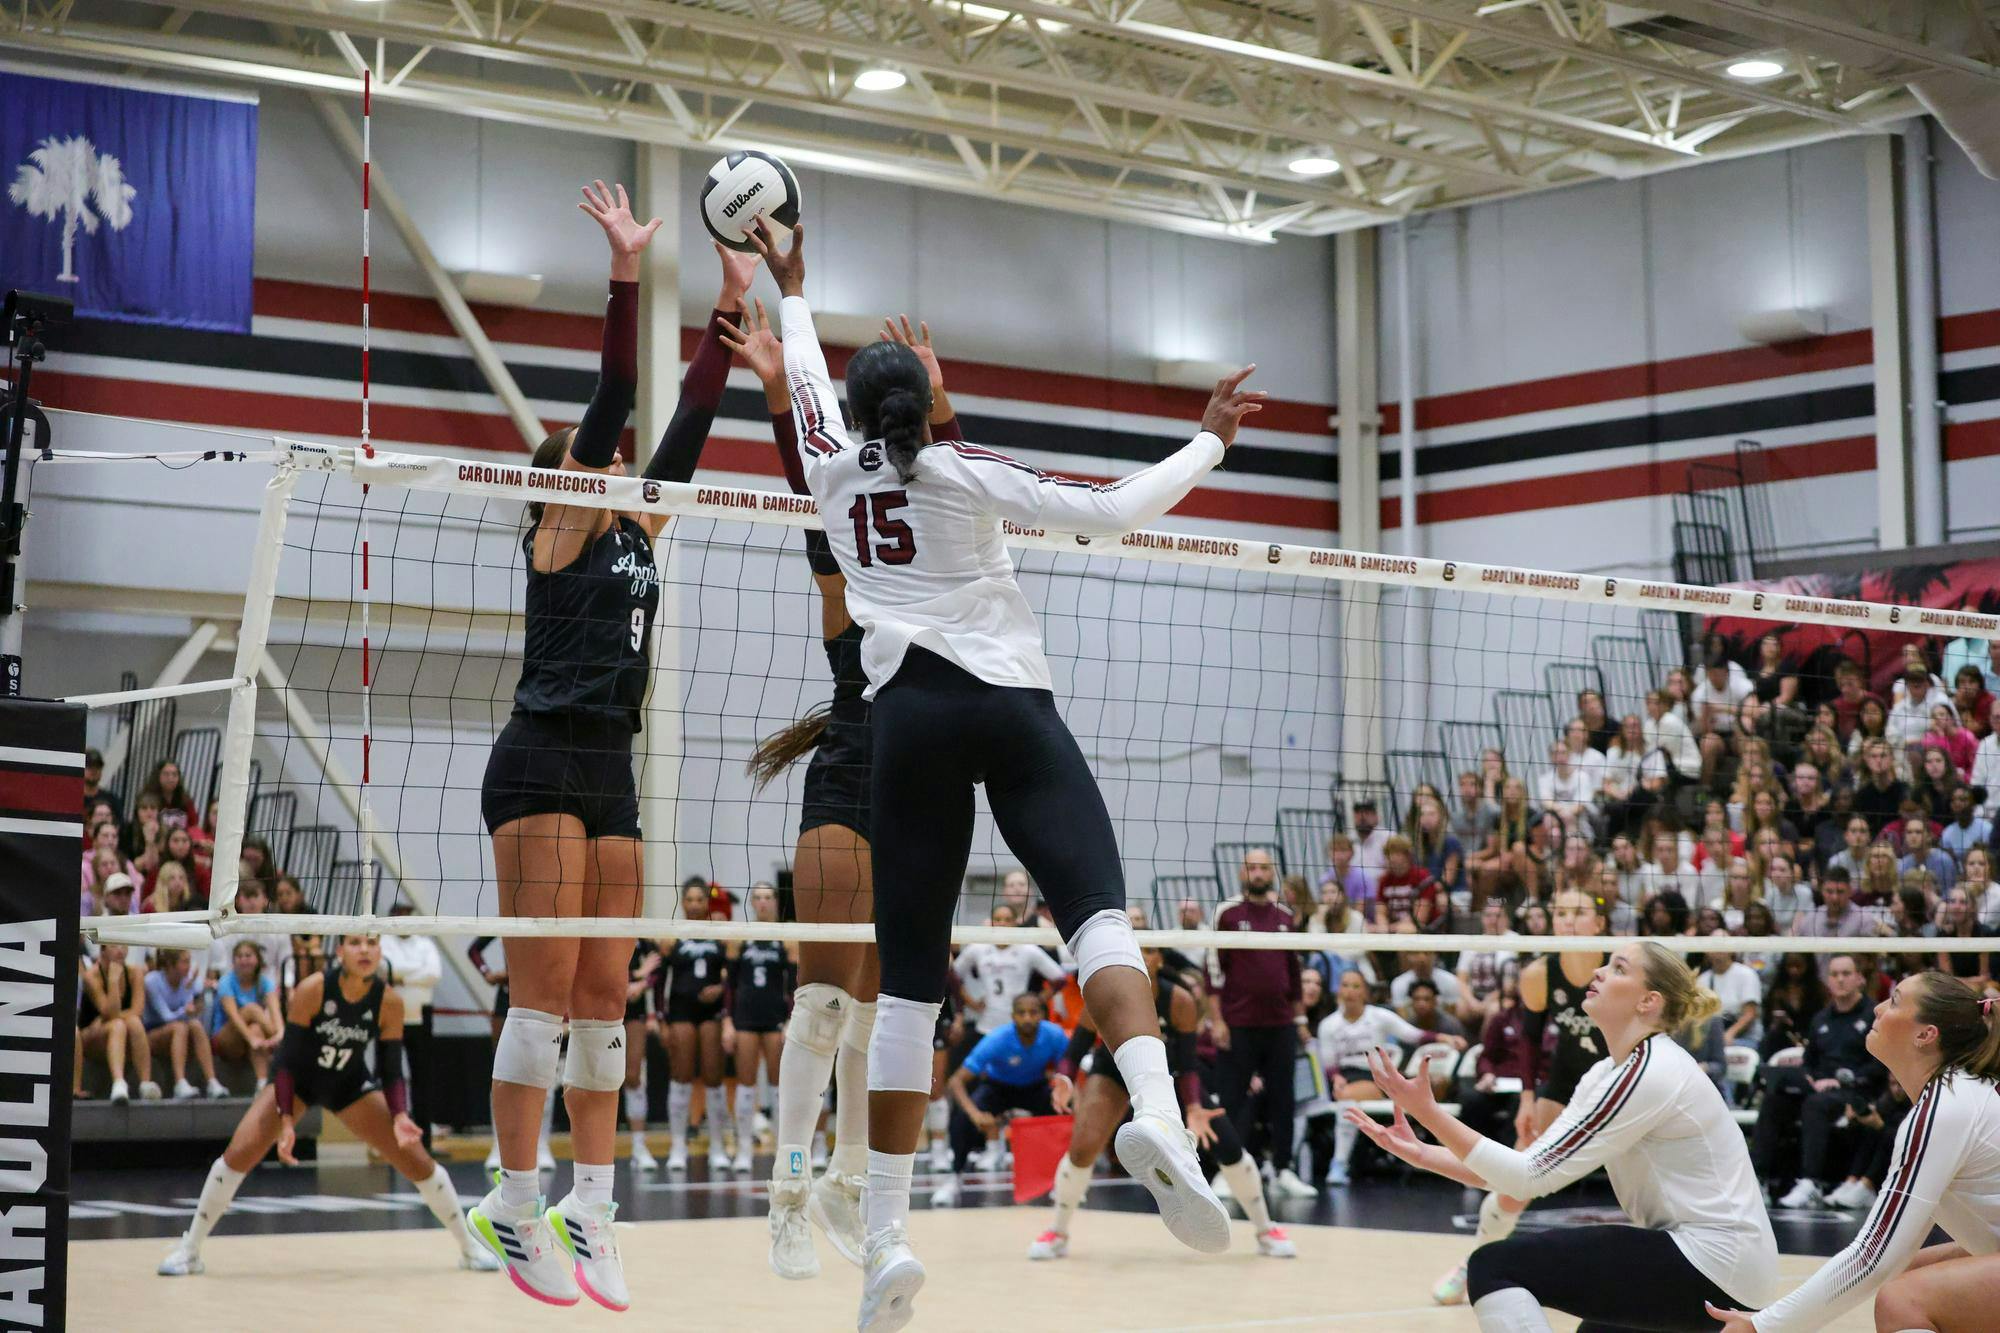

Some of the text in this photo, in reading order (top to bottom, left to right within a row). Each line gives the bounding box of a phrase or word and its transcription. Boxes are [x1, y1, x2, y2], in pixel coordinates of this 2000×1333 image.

[722, 182, 764, 218] Wilson
[297, 444, 327, 454] Senoh
[458, 464, 607, 495] CAROLINA GAMECOCKS
[696, 488, 821, 516] CAROLINA GAMECOC
[848, 489, 917, 568] 15
[1121, 532, 1239, 557] CAROLINA GAMECOCKS
[1309, 551, 1418, 575] CAROLINA GAMECOCKS
[1480, 568, 1580, 591] CAROLINA GAMECOCKS
[1639, 584, 1732, 605] CAROLINA GAMECOCKS
[1784, 599, 1870, 618] CAROLINA GAMECOCKS
[1919, 611, 1999, 630] CAROLINA GAMECOCKS
[631, 607, 645, 652] 9
[318, 1045, 353, 1071] 37
[0, 917, 57, 1333] AROLINA
